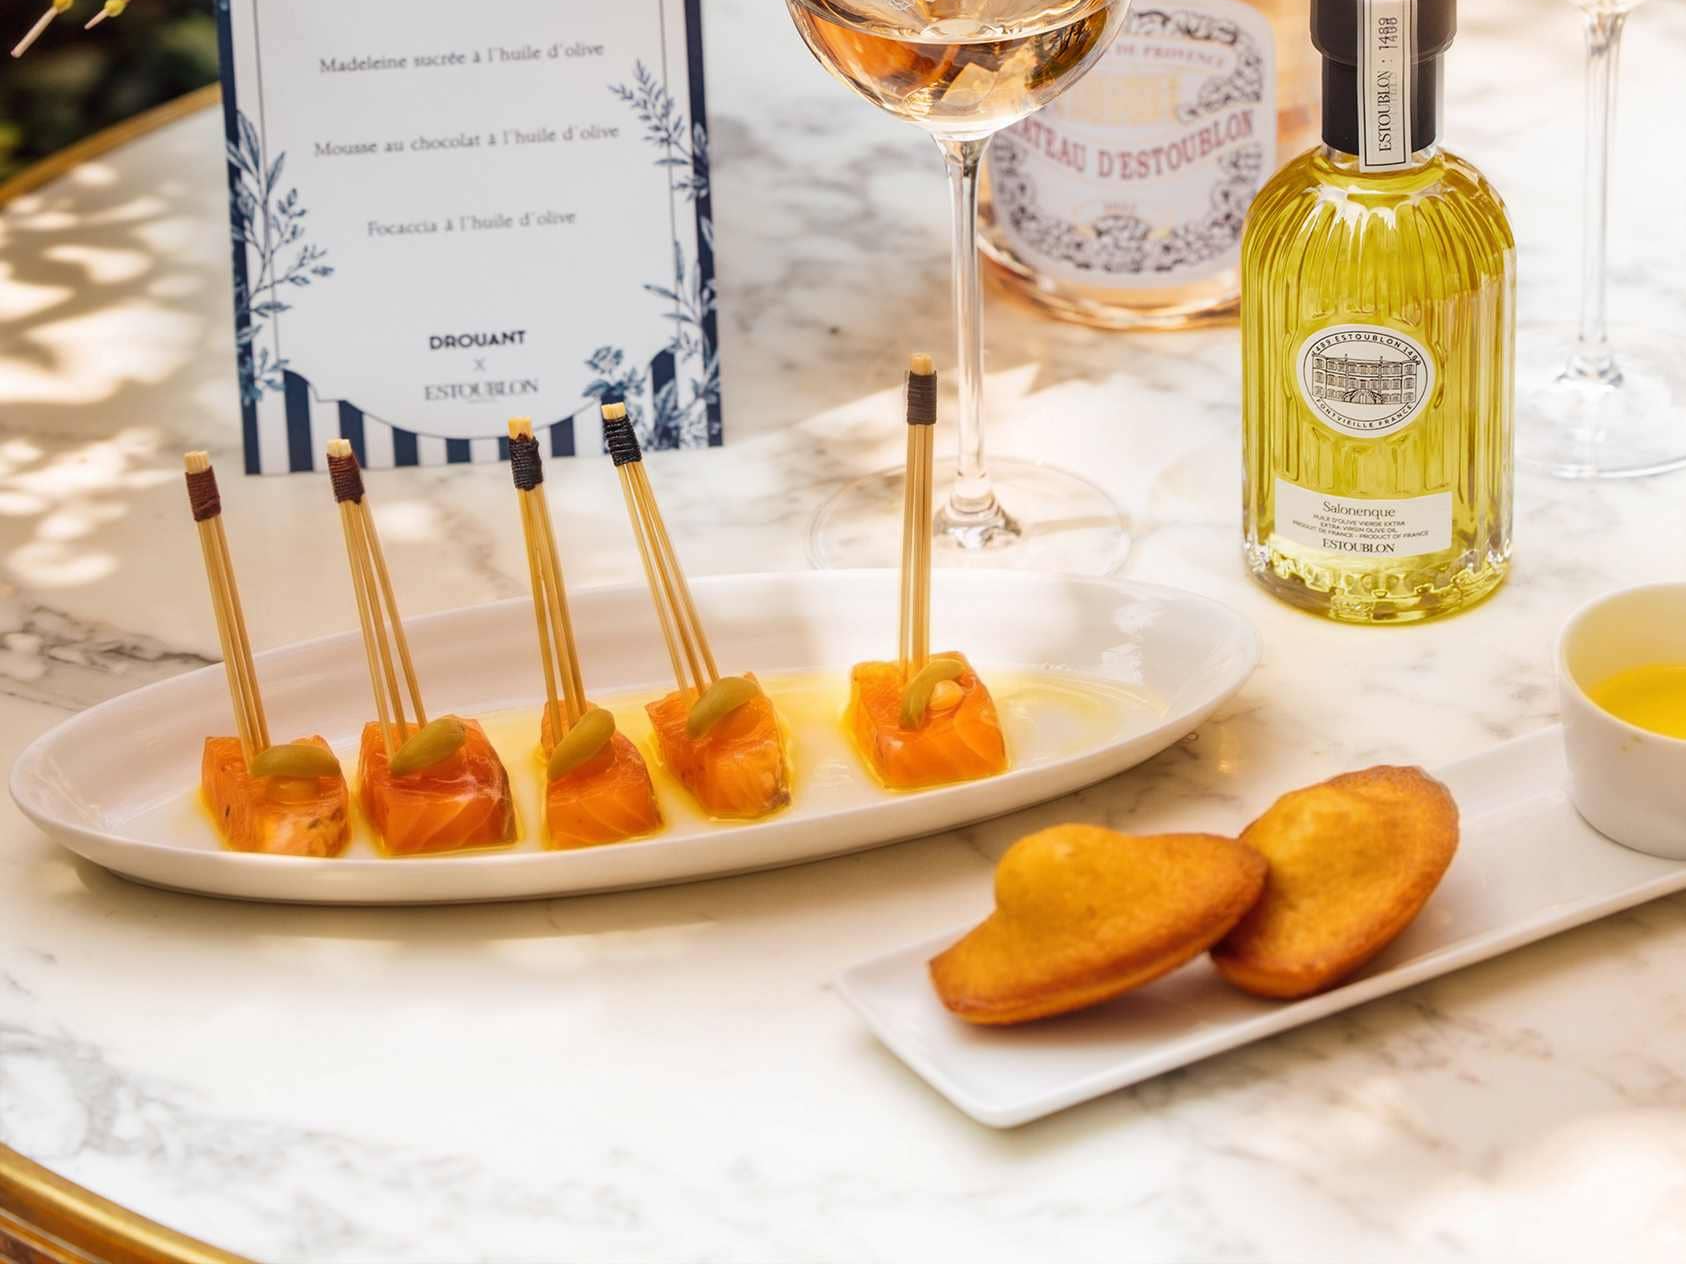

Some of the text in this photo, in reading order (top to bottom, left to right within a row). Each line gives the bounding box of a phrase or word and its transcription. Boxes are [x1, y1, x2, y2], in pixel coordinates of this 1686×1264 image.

[320, 56, 408, 74] Madeleine
[413, 51, 465, 67] sucrée
[473, 49, 482, 64] à
[1377, 70, 1392, 152] ESTOUBLON
[313, 141, 377, 157] Mousse
[384, 140, 404, 153] au
[410, 134, 481, 152] chocolat
[488, 131, 497, 147] à
[1006, 117, 1087, 174] ATEAU
[367, 218, 438, 236] Focaccia
[445, 217, 454, 232] à
[429, 329, 526, 351] DROUANT
[1334, 333, 1402, 348] ESTOUBLON
[424, 378, 540, 401] ESTOUBLON
[1315, 398, 1414, 428] FONTVIEILLE FRANCE
[1322, 501, 1396, 519] Salonenque
[1322, 538, 1396, 554] ESTOUBLON
